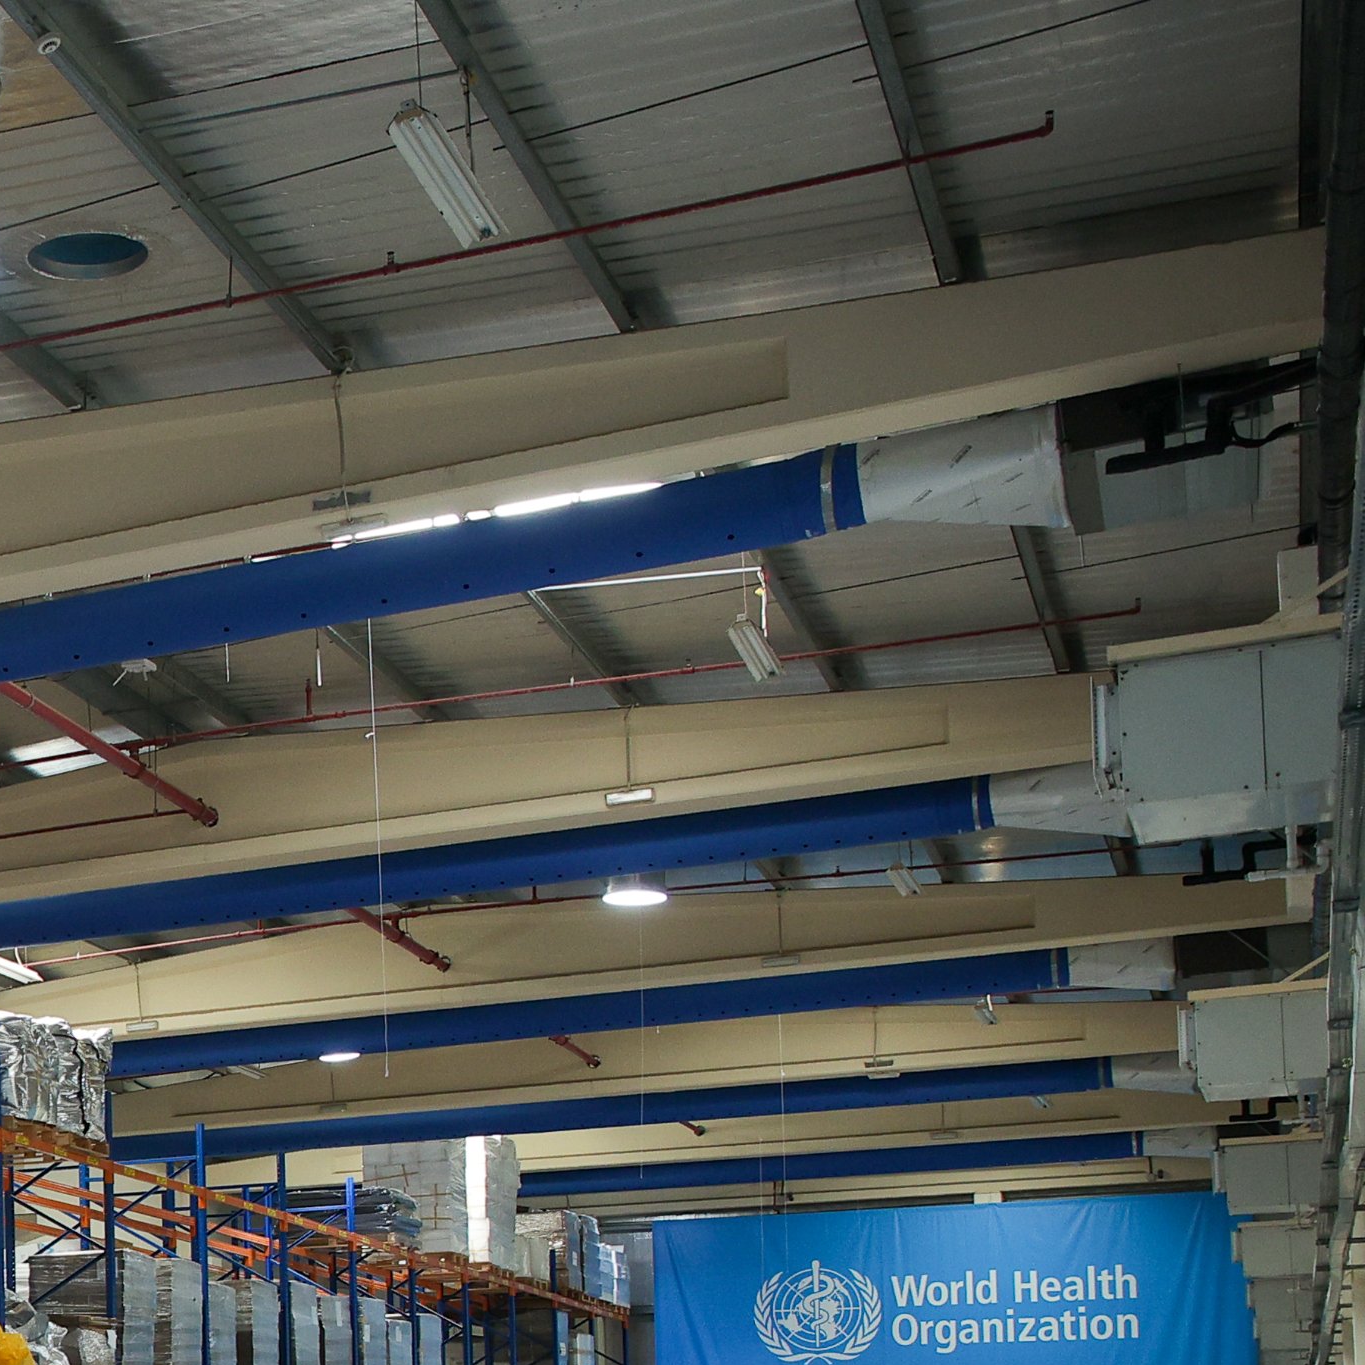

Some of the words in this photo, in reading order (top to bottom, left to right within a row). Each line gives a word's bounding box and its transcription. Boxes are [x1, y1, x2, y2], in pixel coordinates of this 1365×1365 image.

[891, 1270, 997, 1307] World
[1014, 1264, 1138, 1303] Health
[892, 1307, 1139, 1353] Organization
